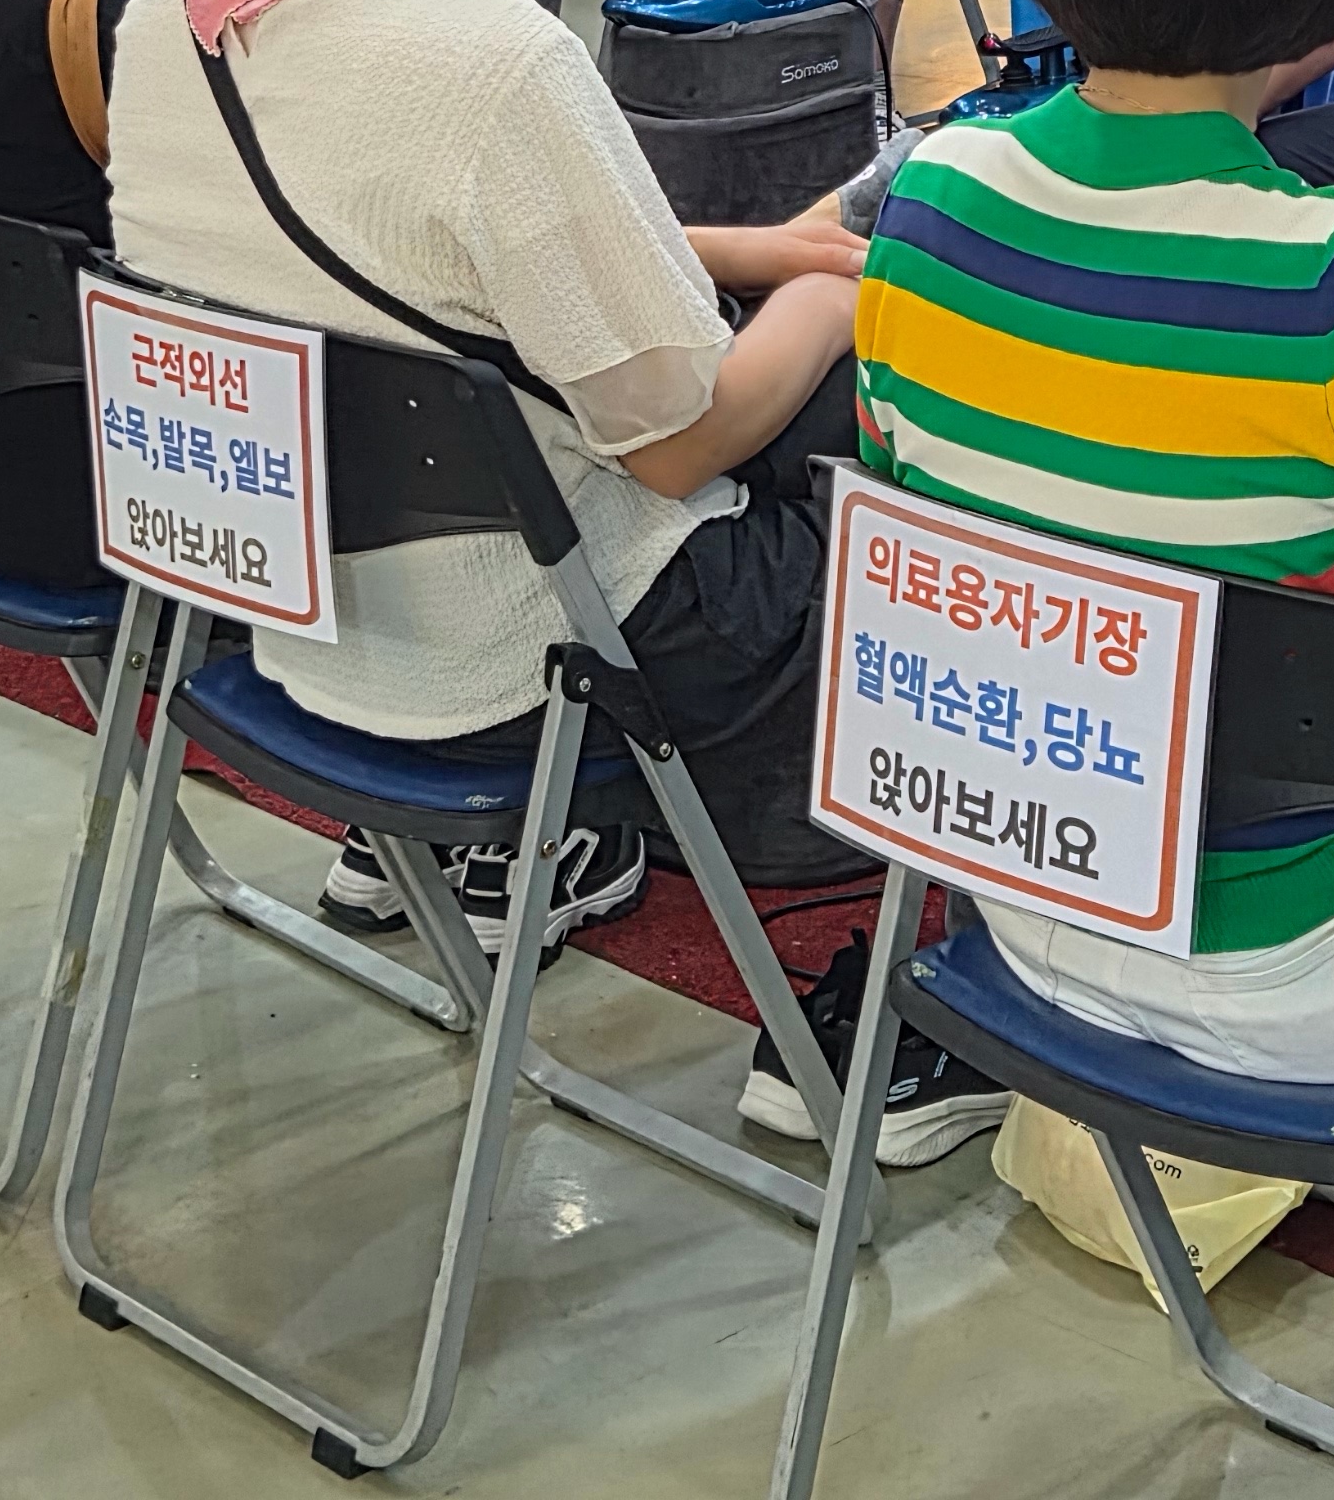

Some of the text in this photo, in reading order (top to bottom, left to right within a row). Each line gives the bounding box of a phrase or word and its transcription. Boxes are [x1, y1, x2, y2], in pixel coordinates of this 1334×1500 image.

[131, 332, 251, 415] 근적외선
[103, 396, 297, 501] 손목,발목,엘보
[126, 496, 274, 590] 앉아보세요
[865, 535, 1149, 677] 의료용자기장
[853, 631, 1146, 787] 혈액순환,당뇨
[868, 746, 1100, 882] 앉아보세요
